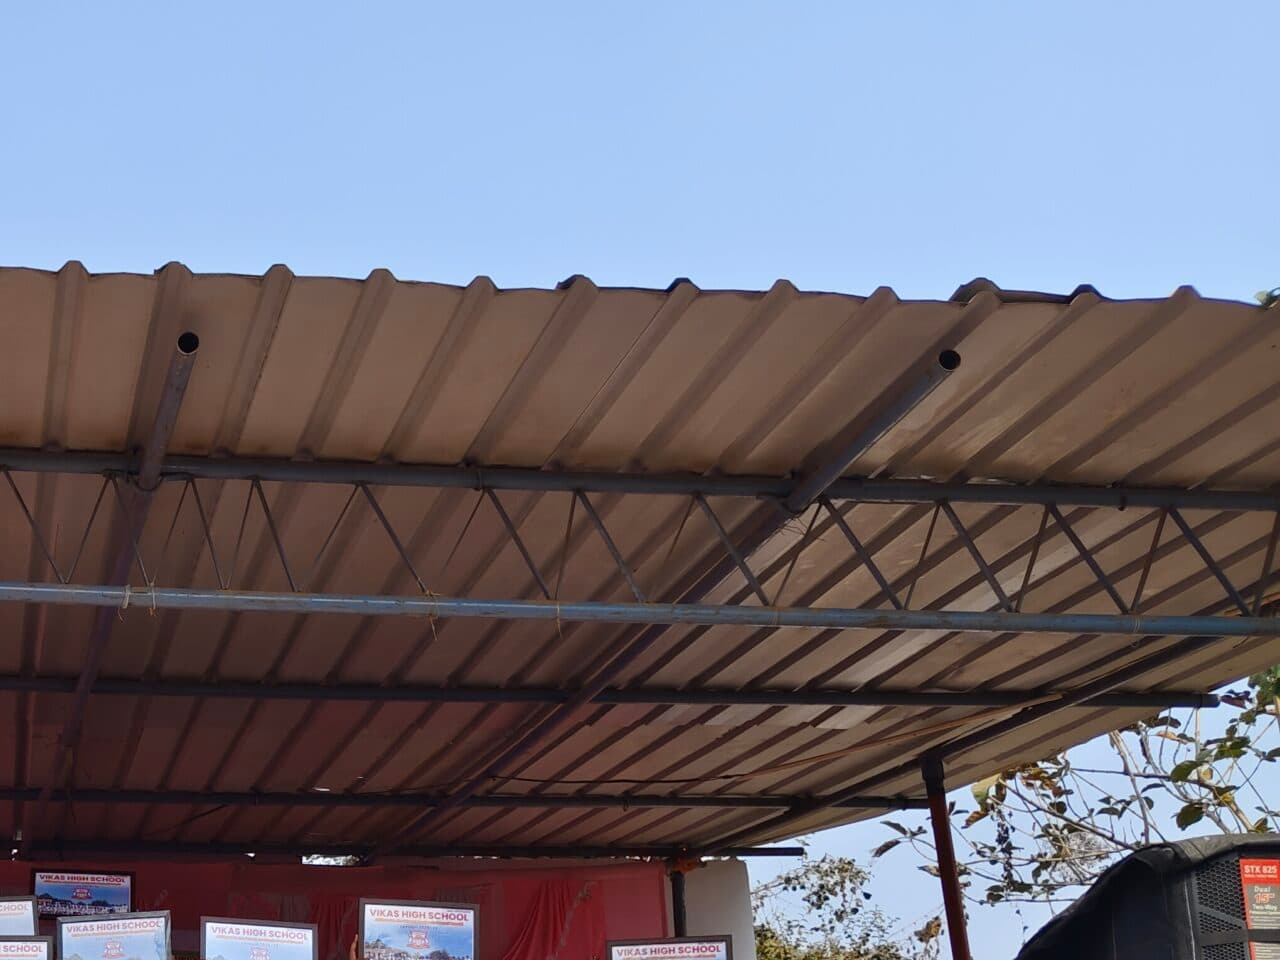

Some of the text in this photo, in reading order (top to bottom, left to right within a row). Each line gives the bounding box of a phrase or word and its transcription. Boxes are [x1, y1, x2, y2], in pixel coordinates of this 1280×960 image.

[1243, 864, 1277, 874] STX 825
[67, 874, 89, 882] HIGH
[90, 875, 126, 883] SCHOOL
[369, 908, 400, 918] VIKAS
[401, 910, 426, 920] HIGH
[428, 911, 469, 922] SCHOOL
[65, 925, 95, 933] VIKAS
[96, 922, 120, 932] HIGH
[121, 920, 161, 930] SCHOOL
[211, 926, 241, 935] VIKAS
[242, 928, 267, 938] HIGH
[269, 930, 308, 940] SCHOOL
[2, 944, 43, 953] SCHOOL
[616, 947, 648, 957] VIKAS
[650, 946, 676, 956] HIGH
[678, 944, 721, 954] SCHOOL
